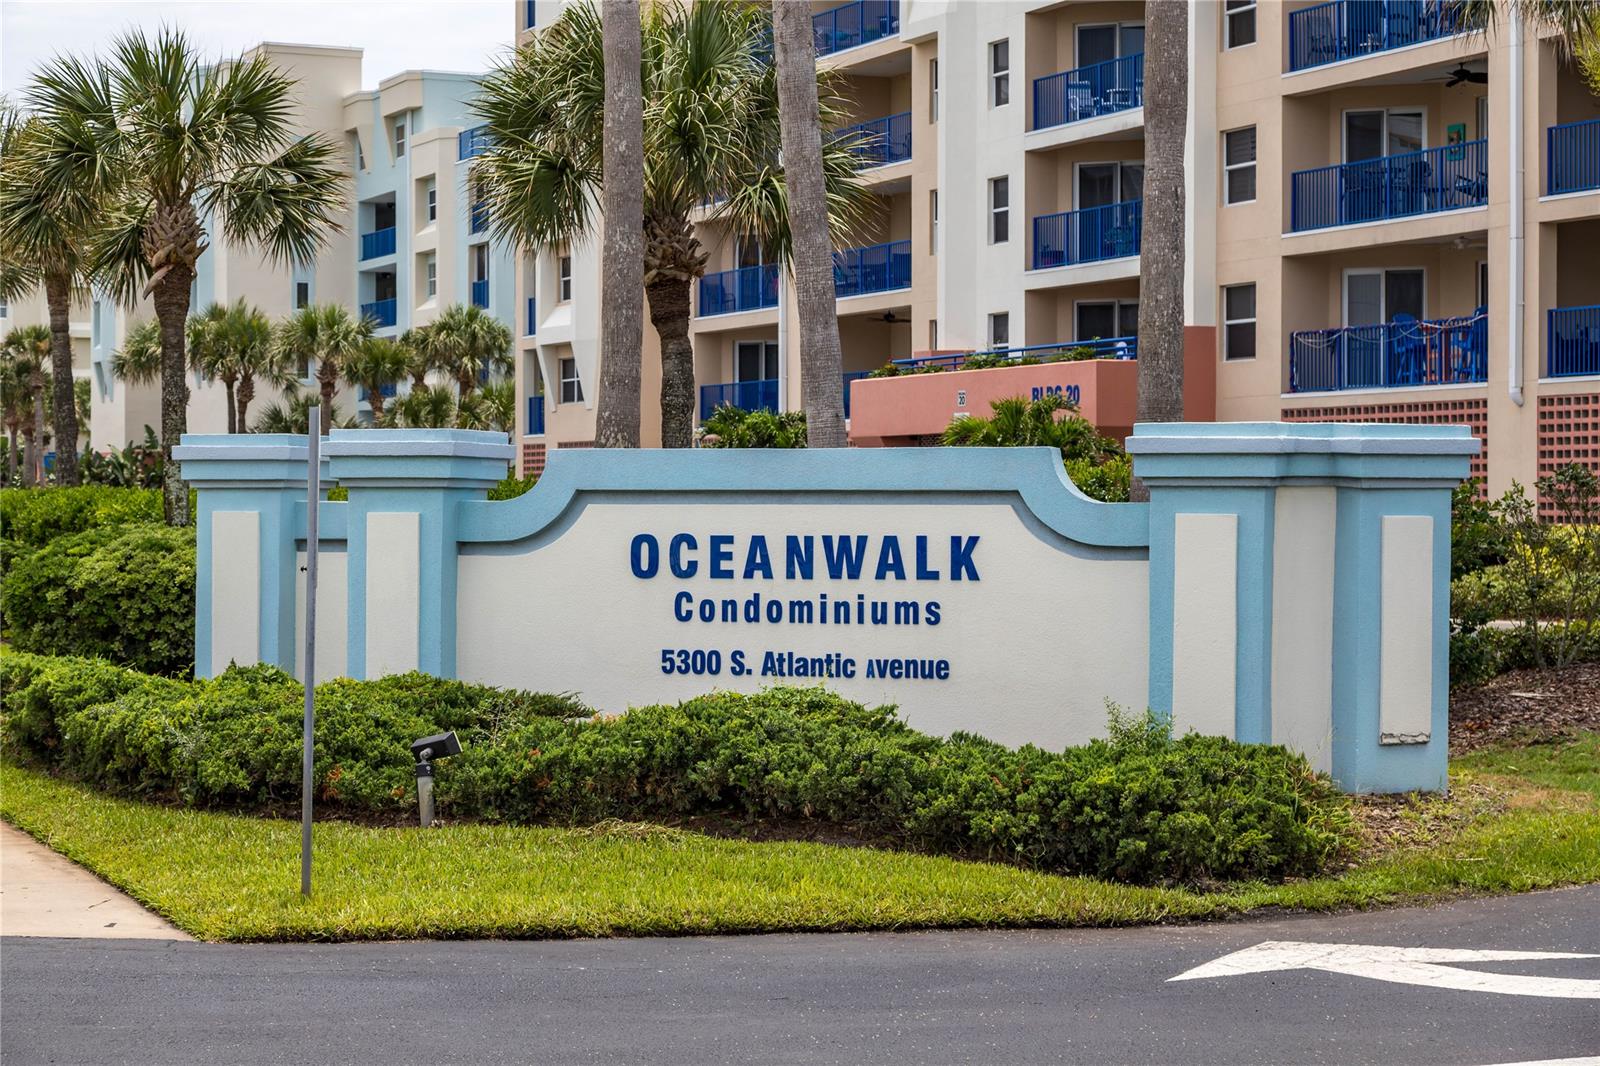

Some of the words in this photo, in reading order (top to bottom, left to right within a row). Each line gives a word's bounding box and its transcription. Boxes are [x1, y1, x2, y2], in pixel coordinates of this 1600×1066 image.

[1066, 384, 1080, 406] 20
[630, 533, 981, 581] OCEANWALK
[674, 591, 941, 625] Condominiums
[661, 649, 722, 675] 5300
[730, 650, 753, 676] S.
[761, 651, 856, 678] Atlantic
[866, 658, 950, 680] Avenue
